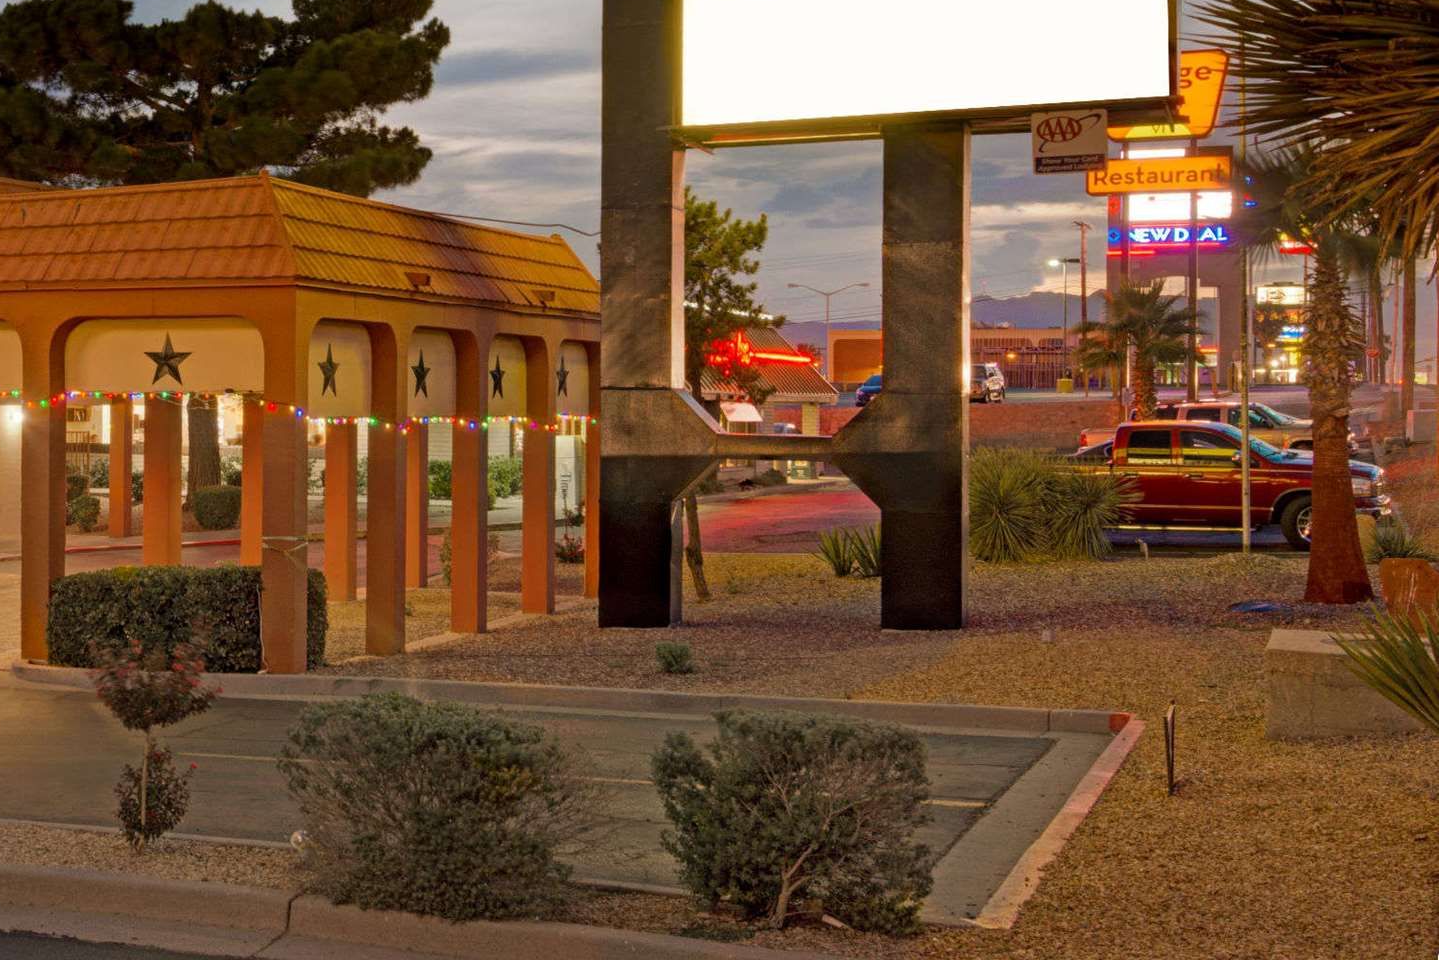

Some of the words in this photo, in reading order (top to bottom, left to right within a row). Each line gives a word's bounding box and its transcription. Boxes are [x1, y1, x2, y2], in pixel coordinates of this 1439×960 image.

[1040, 116, 1079, 142] AAA
[1093, 162, 1225, 187] Restaurant
[1173, 227, 1228, 242] DAL
